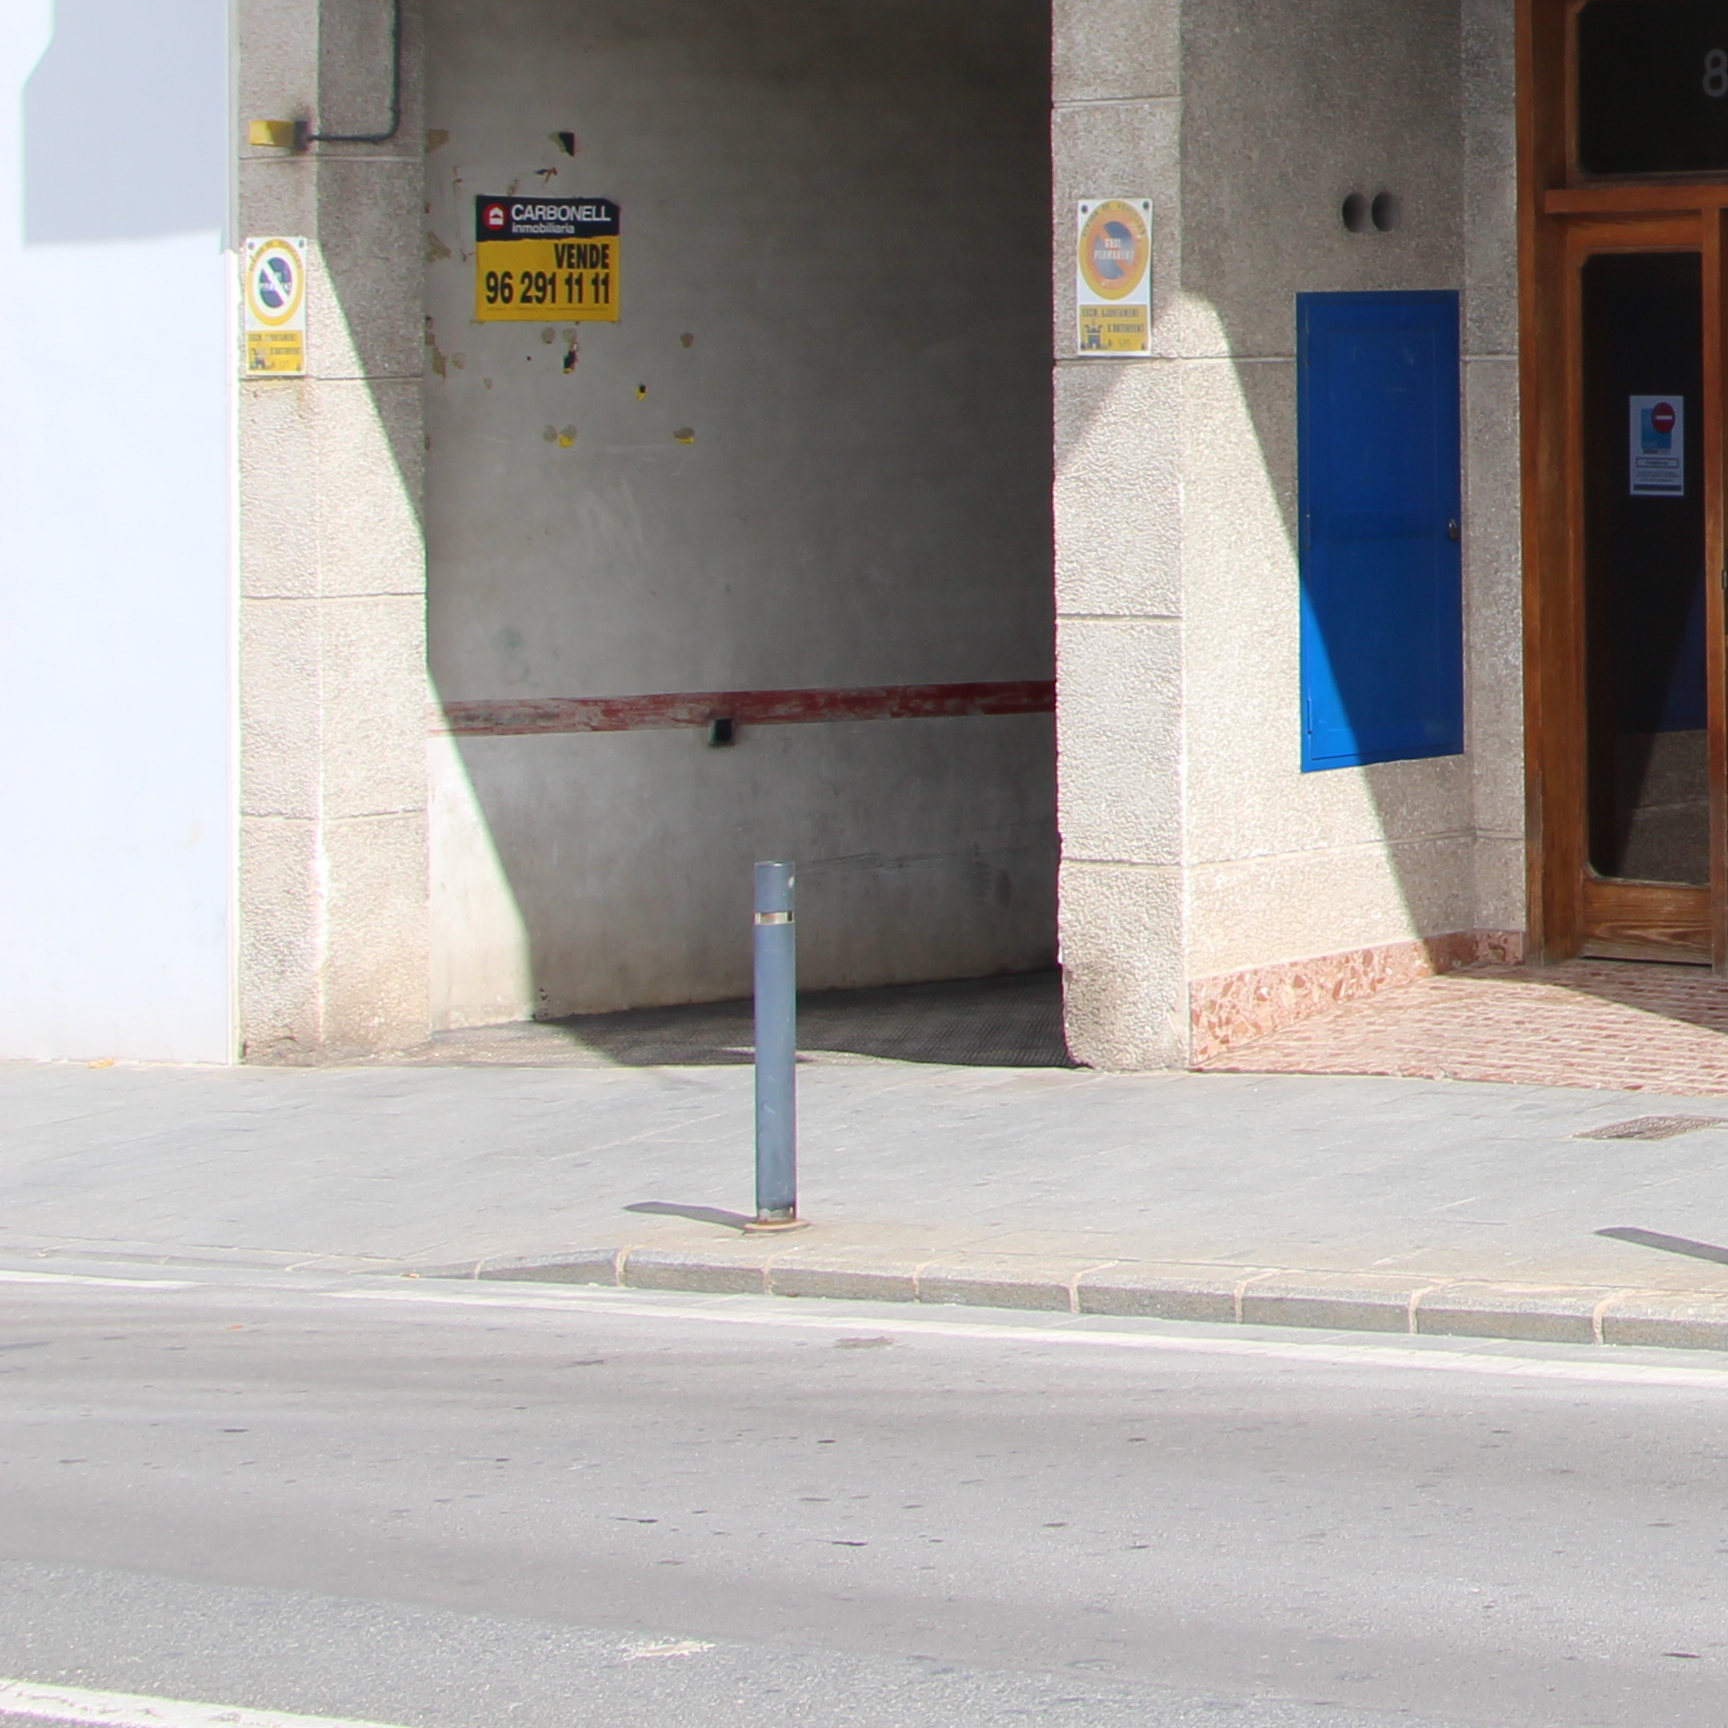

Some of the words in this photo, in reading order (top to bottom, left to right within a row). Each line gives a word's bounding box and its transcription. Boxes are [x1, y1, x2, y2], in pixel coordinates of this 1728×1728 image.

[511, 204, 612, 221] CARBONELL
[512, 222, 575, 234] inmobiliaria
[553, 243, 610, 270] VENDE
[486, 270, 514, 305] 96
[519, 270, 557, 305] 291
[565, 270, 583, 304] 11
[591, 270, 610, 304] 11
